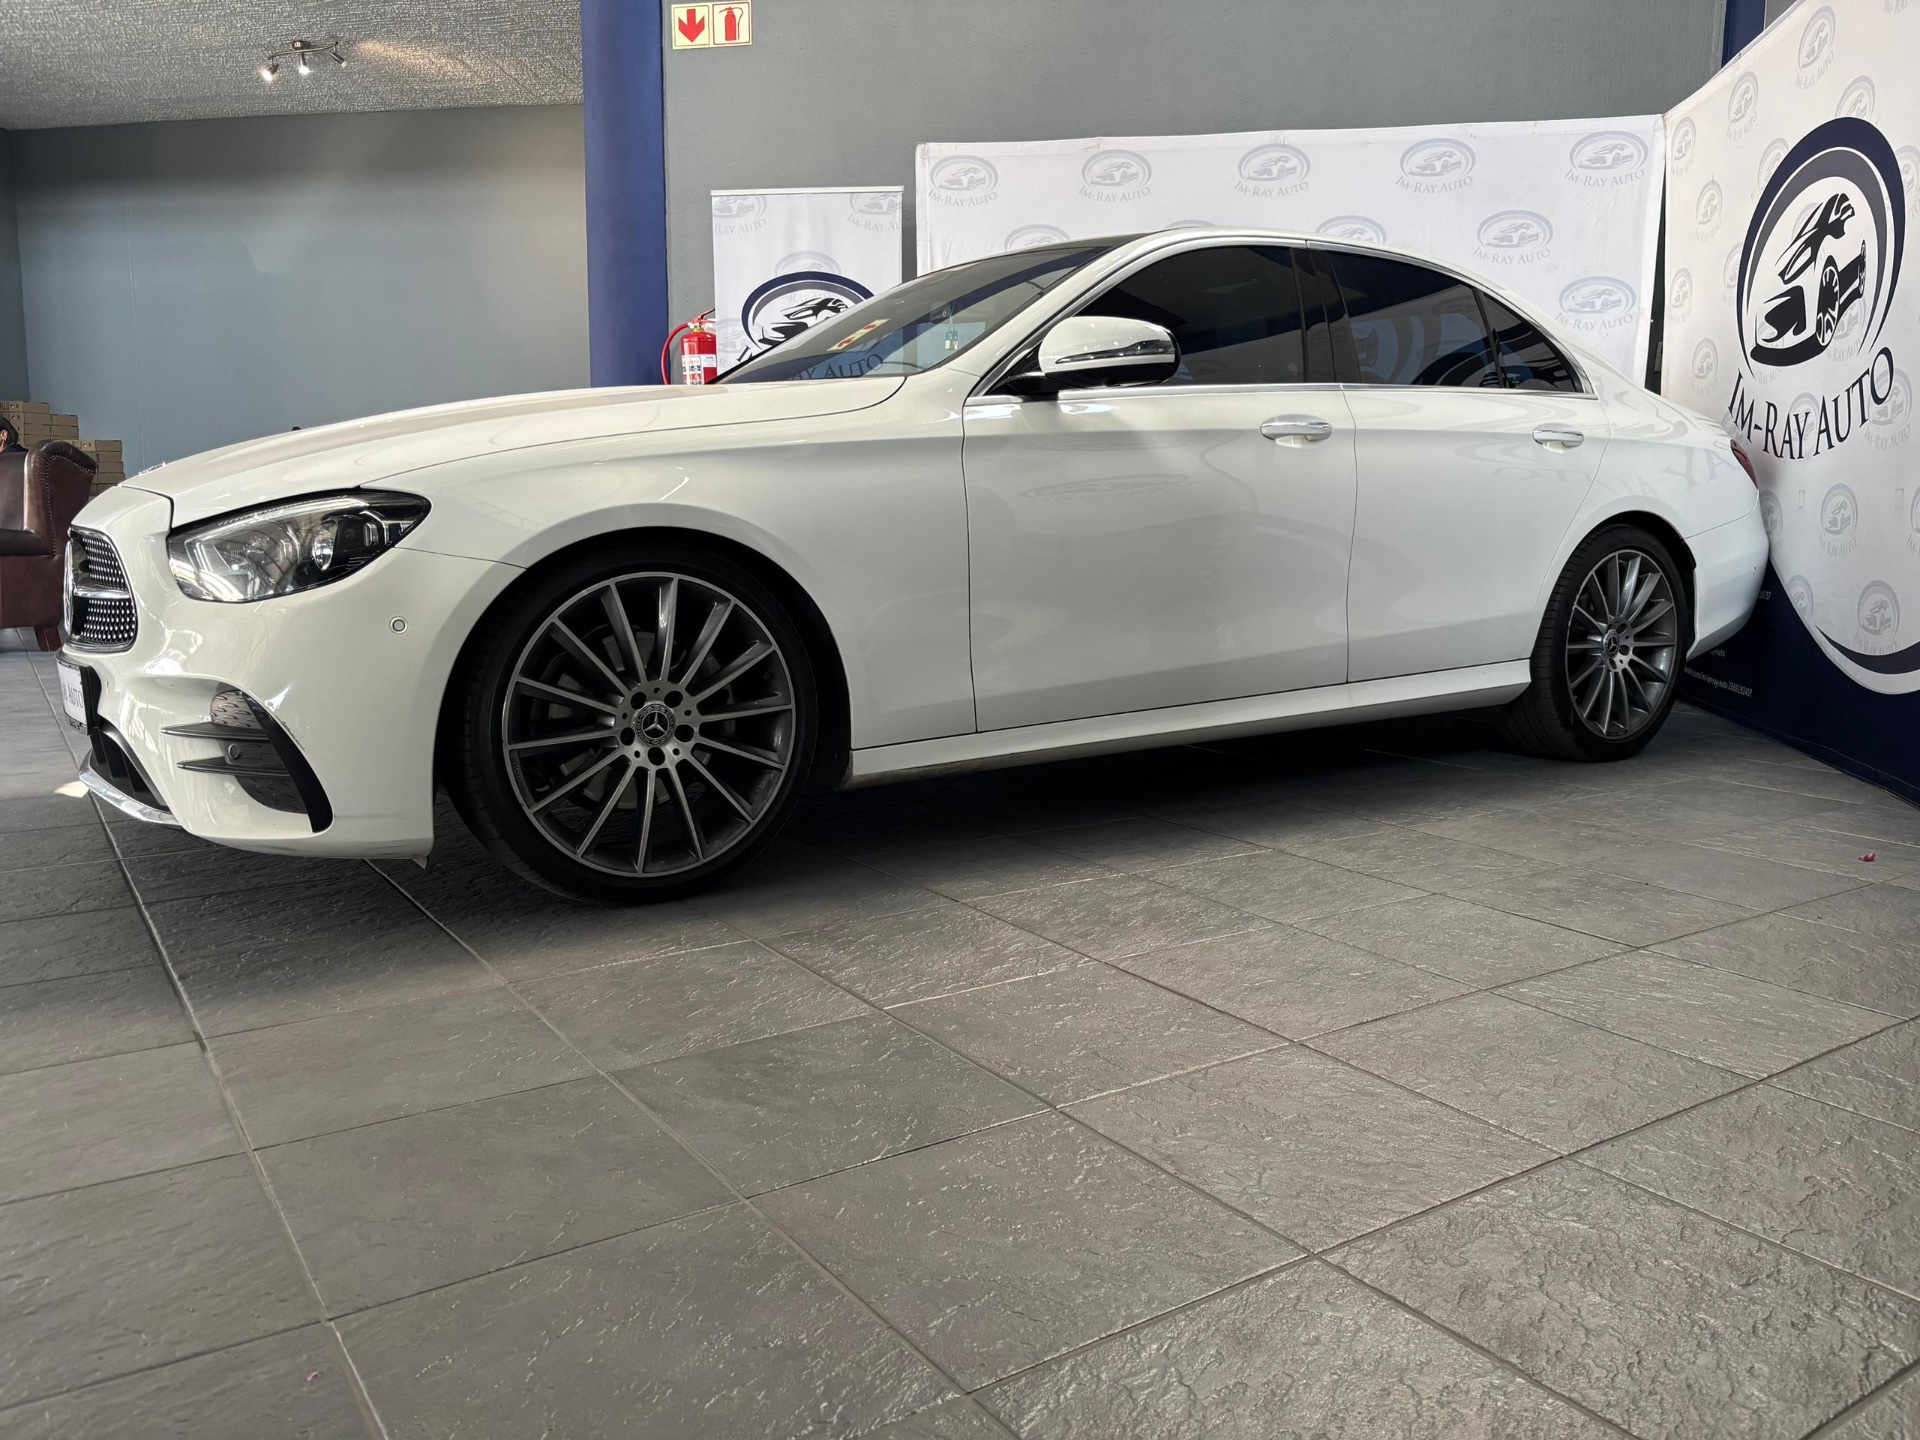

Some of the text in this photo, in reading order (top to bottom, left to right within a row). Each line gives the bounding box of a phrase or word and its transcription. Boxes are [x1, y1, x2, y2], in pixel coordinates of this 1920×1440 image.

[1395, 176, 1474, 194] IM-RAY AUTO
[1564, 169, 1645, 187] IM-RAY AUTO
[1078, 185, 1151, 203] IM-RAY AUTO
[1234, 180, 1309, 198] IM-RAY AUTO
[928, 190, 998, 207] IM-RAY AUTO
[738, 218, 768, 234] AUTO
[1473, 247, 1551, 265] IM-RAY AUTO
[1554, 312, 1633, 331] IM-RAY AUTO
[824, 353, 884, 378] AUTO
[1727, 346, 1895, 460] IM-RAY AUTO
